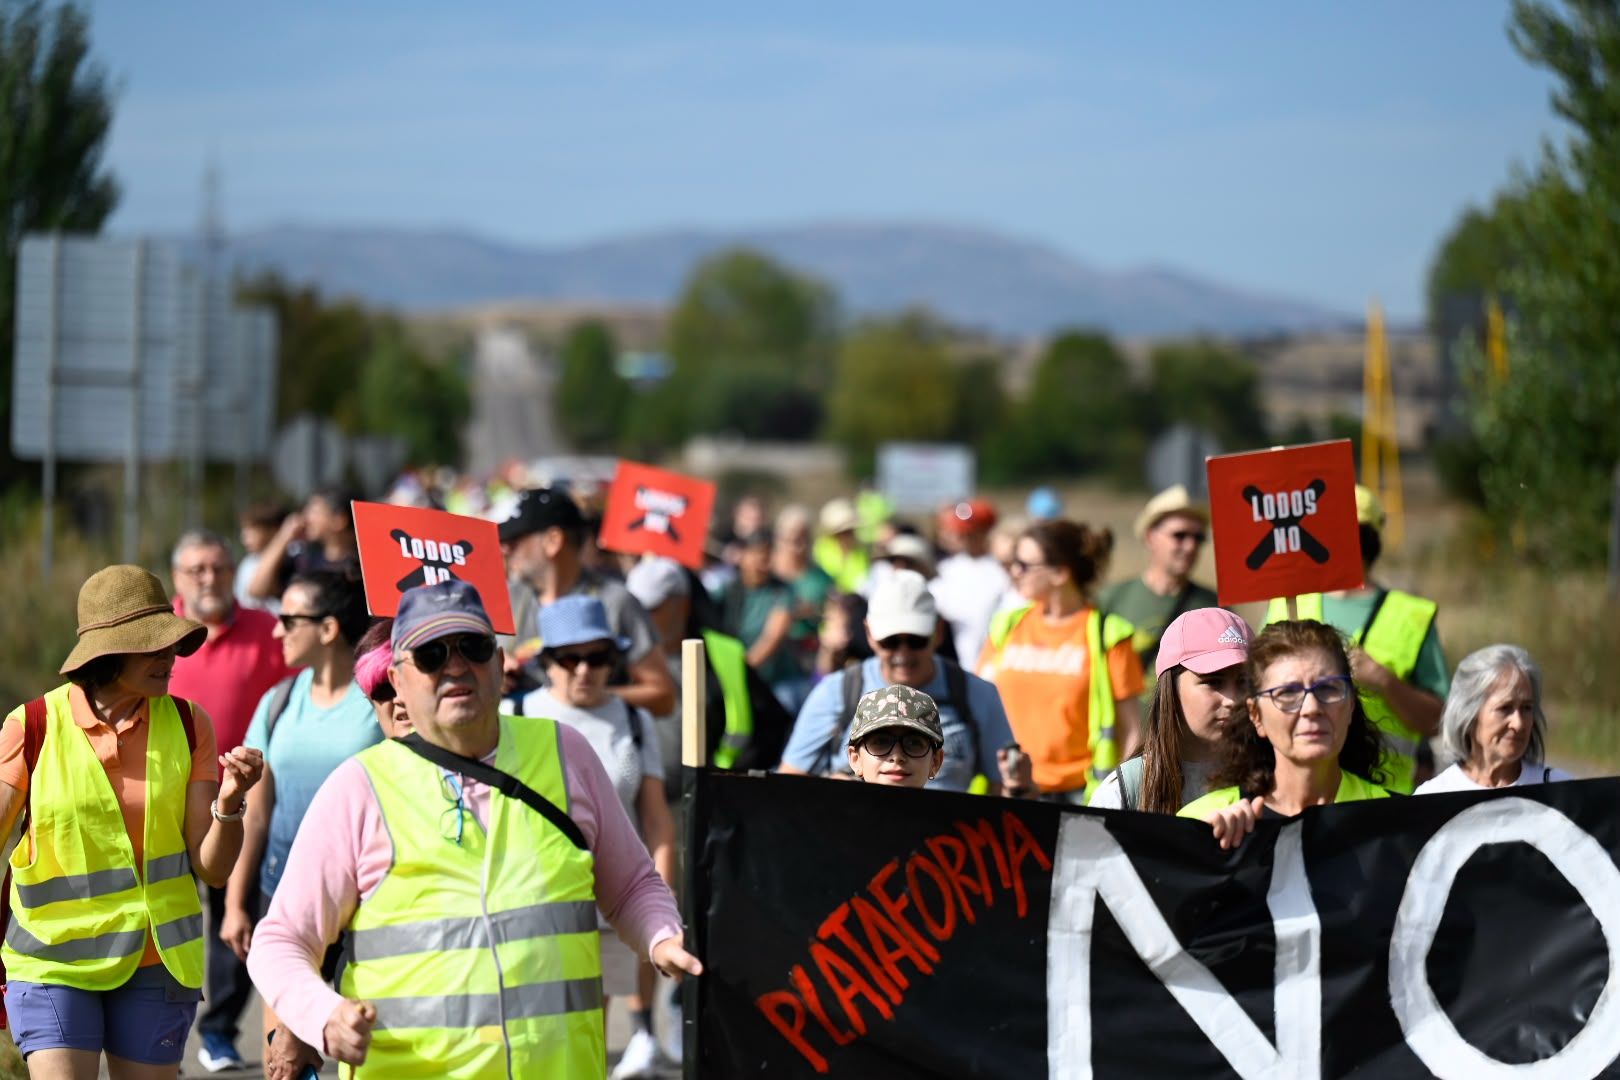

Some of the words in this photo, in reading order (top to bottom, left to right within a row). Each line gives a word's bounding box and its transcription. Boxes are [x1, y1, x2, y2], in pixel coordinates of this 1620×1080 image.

[1251, 487, 1318, 523] LODOS
[399, 536, 467, 567] LODOS
[1273, 525, 1302, 555] NO
[756, 810, 1052, 1074] PLATAFORMA
[1046, 796, 1620, 1080] NO
